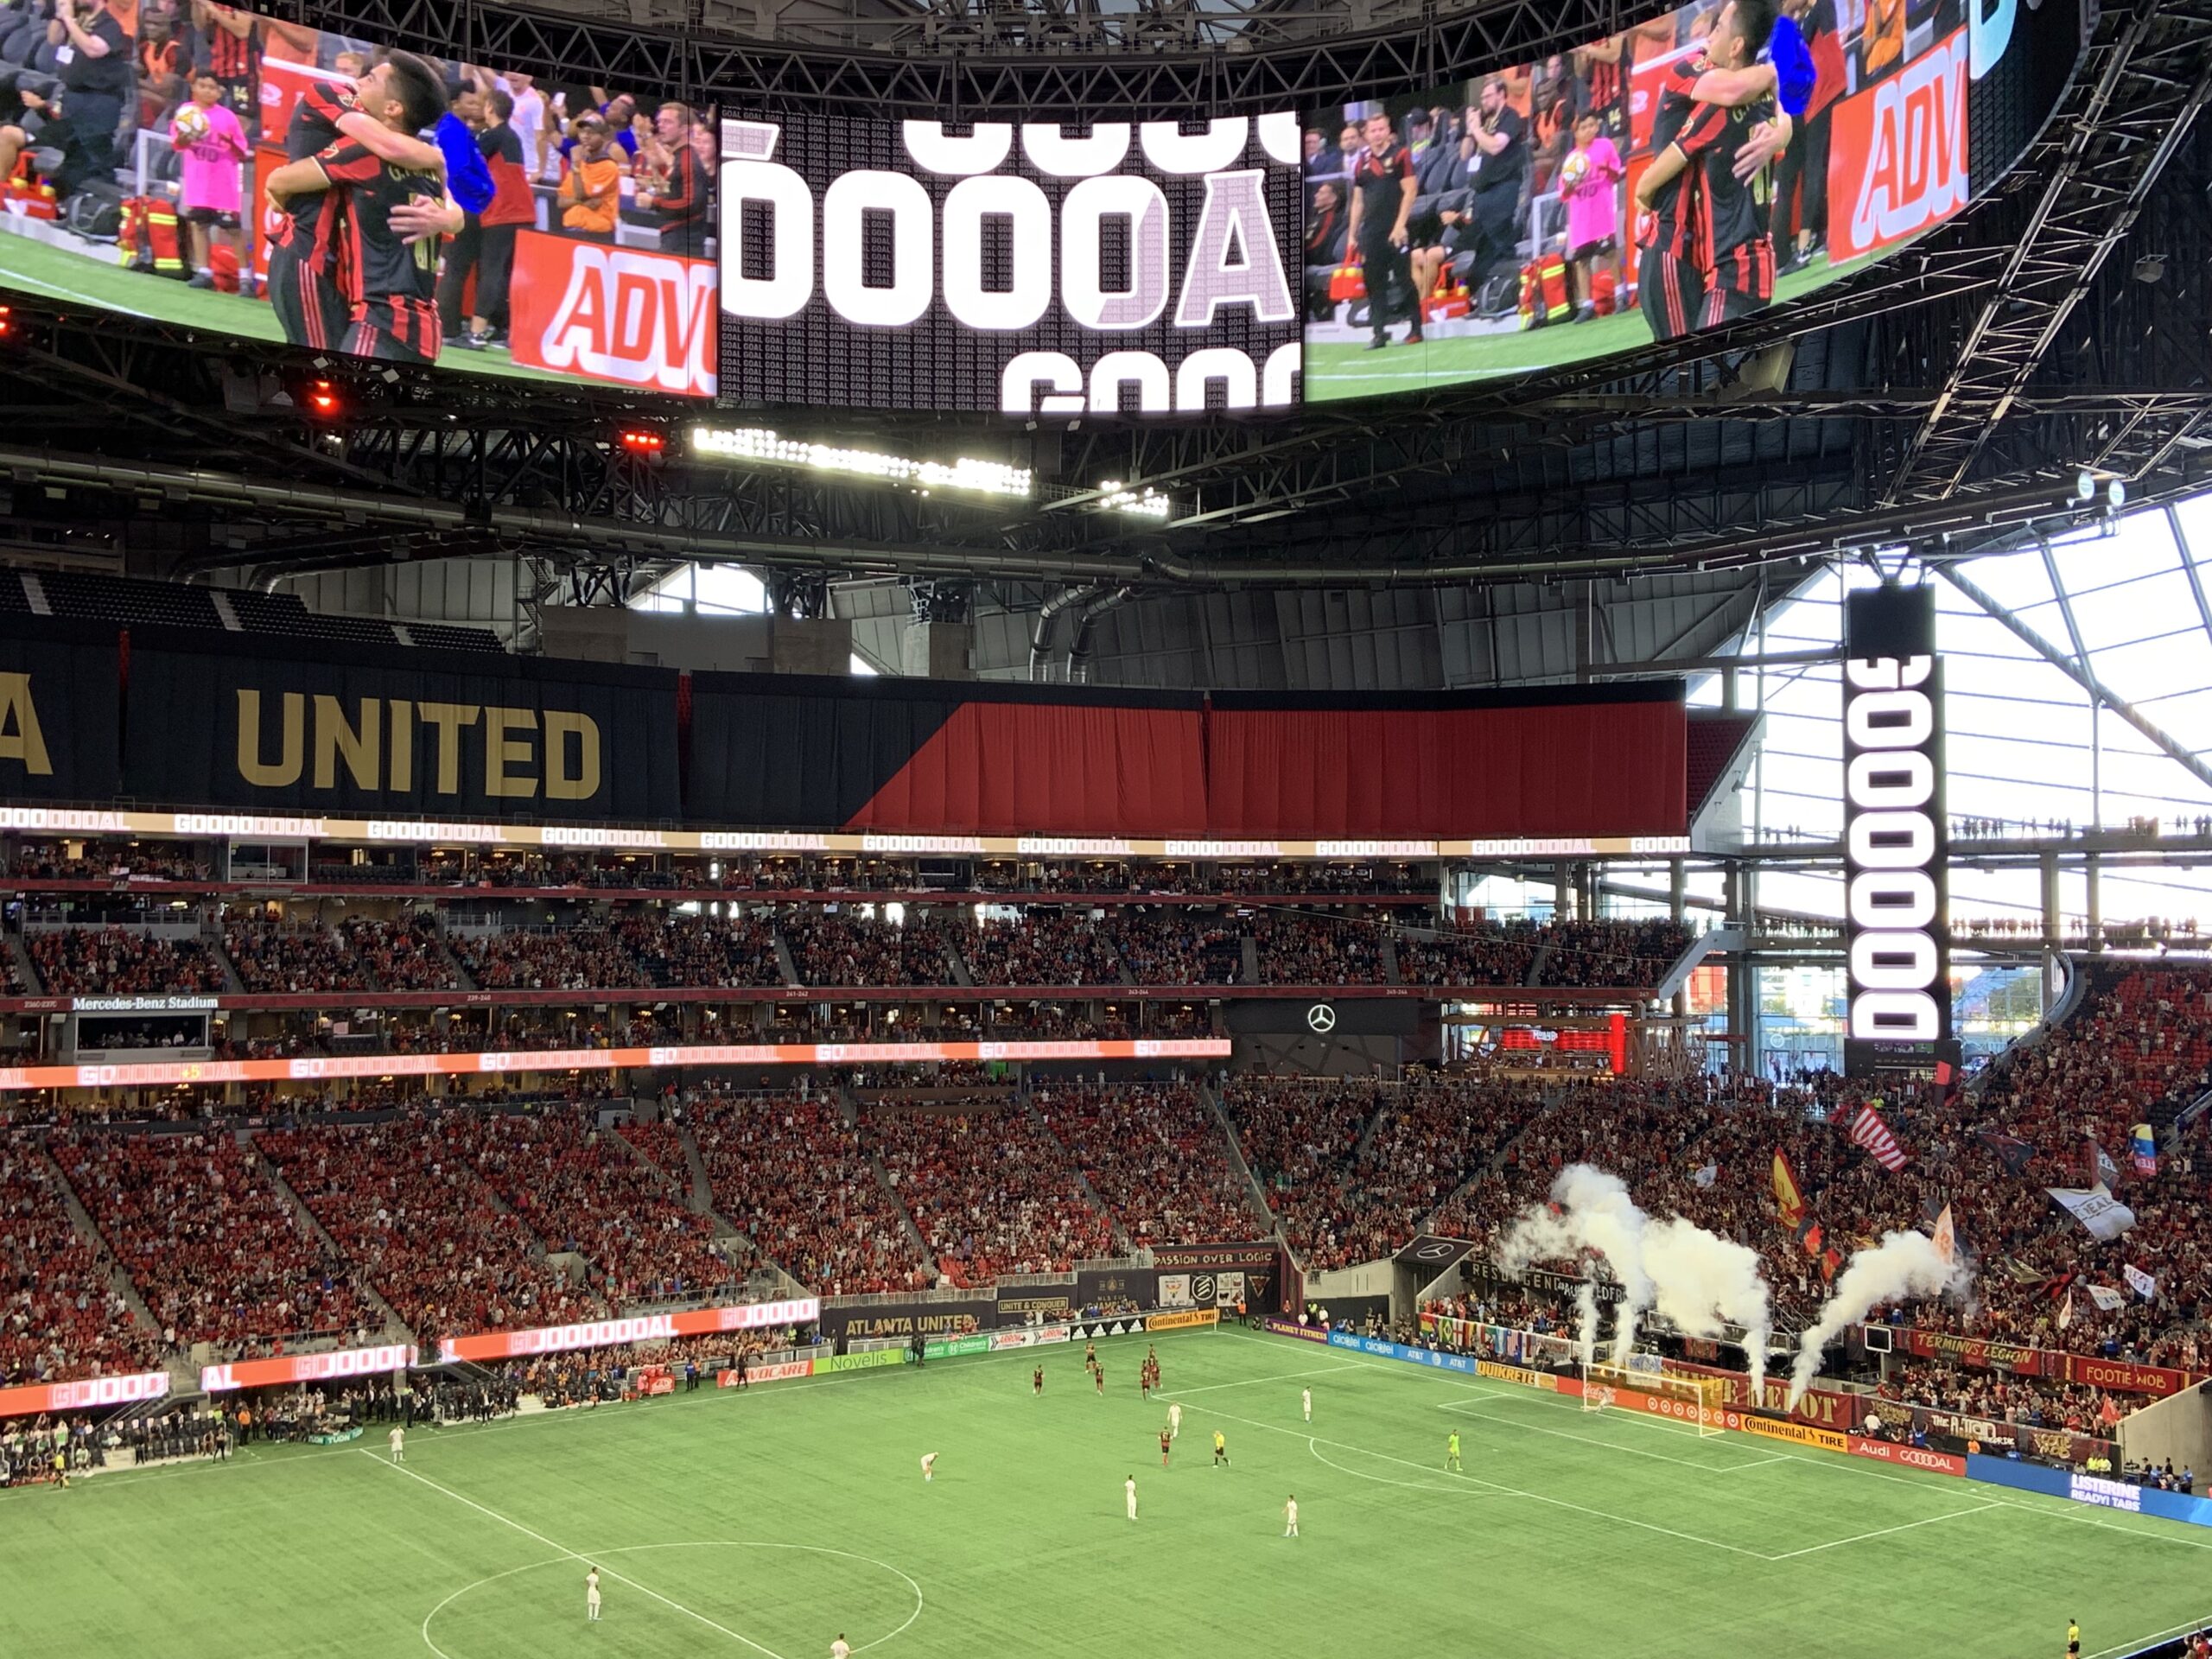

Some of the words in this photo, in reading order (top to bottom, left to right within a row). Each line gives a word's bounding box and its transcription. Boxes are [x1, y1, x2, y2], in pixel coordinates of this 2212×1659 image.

[1851, 29, 1968, 247] ADV
[543, 245, 716, 395] ADV
[237, 688, 601, 802] UNITED
[73, 997, 166, 1010] Mercedes-Benz
[168, 996, 219, 1009] Stadium
[1203, 1253, 1234, 1264] OVER
[1001, 1302, 1023, 1311] UNITE
[1032, 1300, 1066, 1309] CONQUER
[845, 1317, 913, 1336] ATLANTA
[918, 1314, 973, 1332] UNITED
[1148, 1314, 1192, 1329] Continental
[1273, 1322, 1299, 1335] PLANET
[1300, 1327, 1327, 1341] FITNESS
[1408, 1351, 1424, 1360] AT&T
[1917, 1333, 1980, 1356] TERMINUS
[1982, 1344, 2033, 1364] LEGION
[830, 1351, 887, 1371] Novelis
[1449, 1357, 1466, 1369] AT&T
[725, 1361, 808, 1386] AVOCARE
[1477, 1360, 1535, 1385] QUIKRETE
[2086, 1365, 2132, 1386] FOOTIE
[2136, 1374, 2167, 1389] MOB
[1930, 1414, 1950, 1427] THE
[1745, 1416, 1806, 1440] Continental
[1818, 1434, 1845, 1448] TIRE
[1859, 1441, 1891, 1458] Audi
[2071, 1473, 2142, 1501] LISTERINE
[2071, 1489, 2110, 1506] READY!
[2112, 1497, 2141, 1512] TABS
